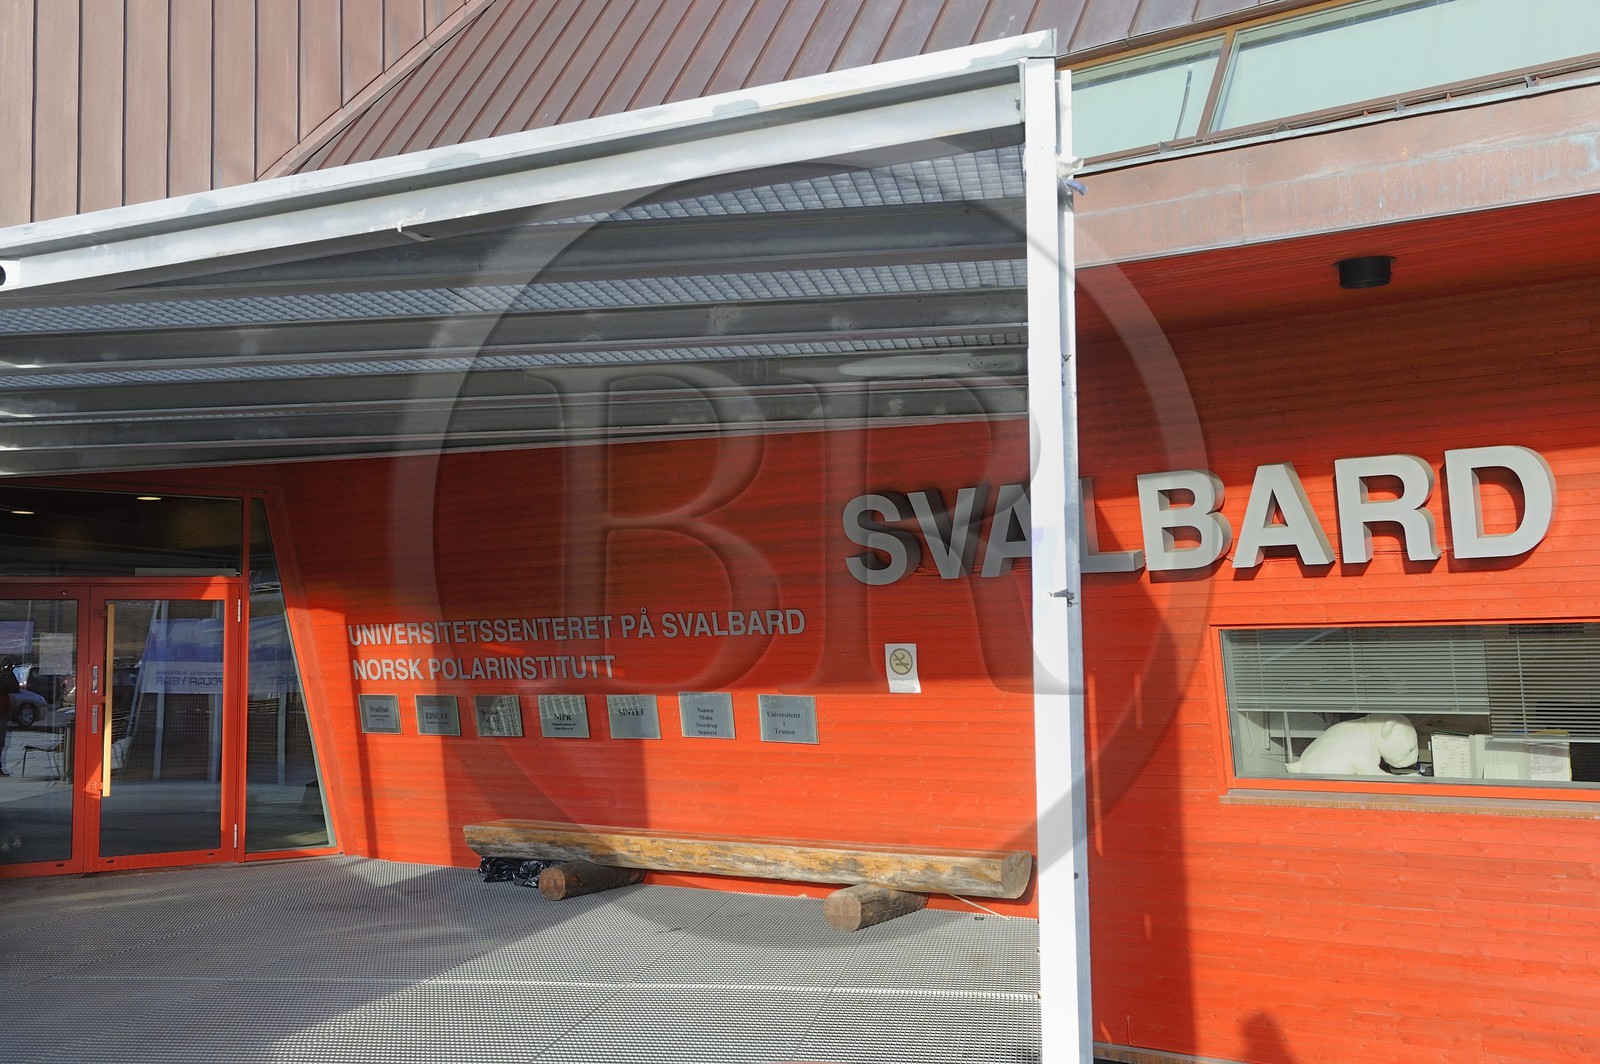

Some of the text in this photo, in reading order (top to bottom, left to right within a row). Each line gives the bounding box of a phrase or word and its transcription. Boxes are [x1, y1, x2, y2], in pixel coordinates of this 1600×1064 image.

[841, 445, 1556, 586] SVALBARD
[348, 607, 806, 646] UNIVERSITETSSENTERET PÅ SVALBARD
[352, 655, 616, 680] NORSK POLARINSTITUTT
[369, 705, 389, 713] SvalSat
[618, 707, 645, 716] SINTEF
[425, 711, 448, 720] EISCAT
[554, 713, 572, 721] NIPR
[766, 711, 801, 719] Universitetet
